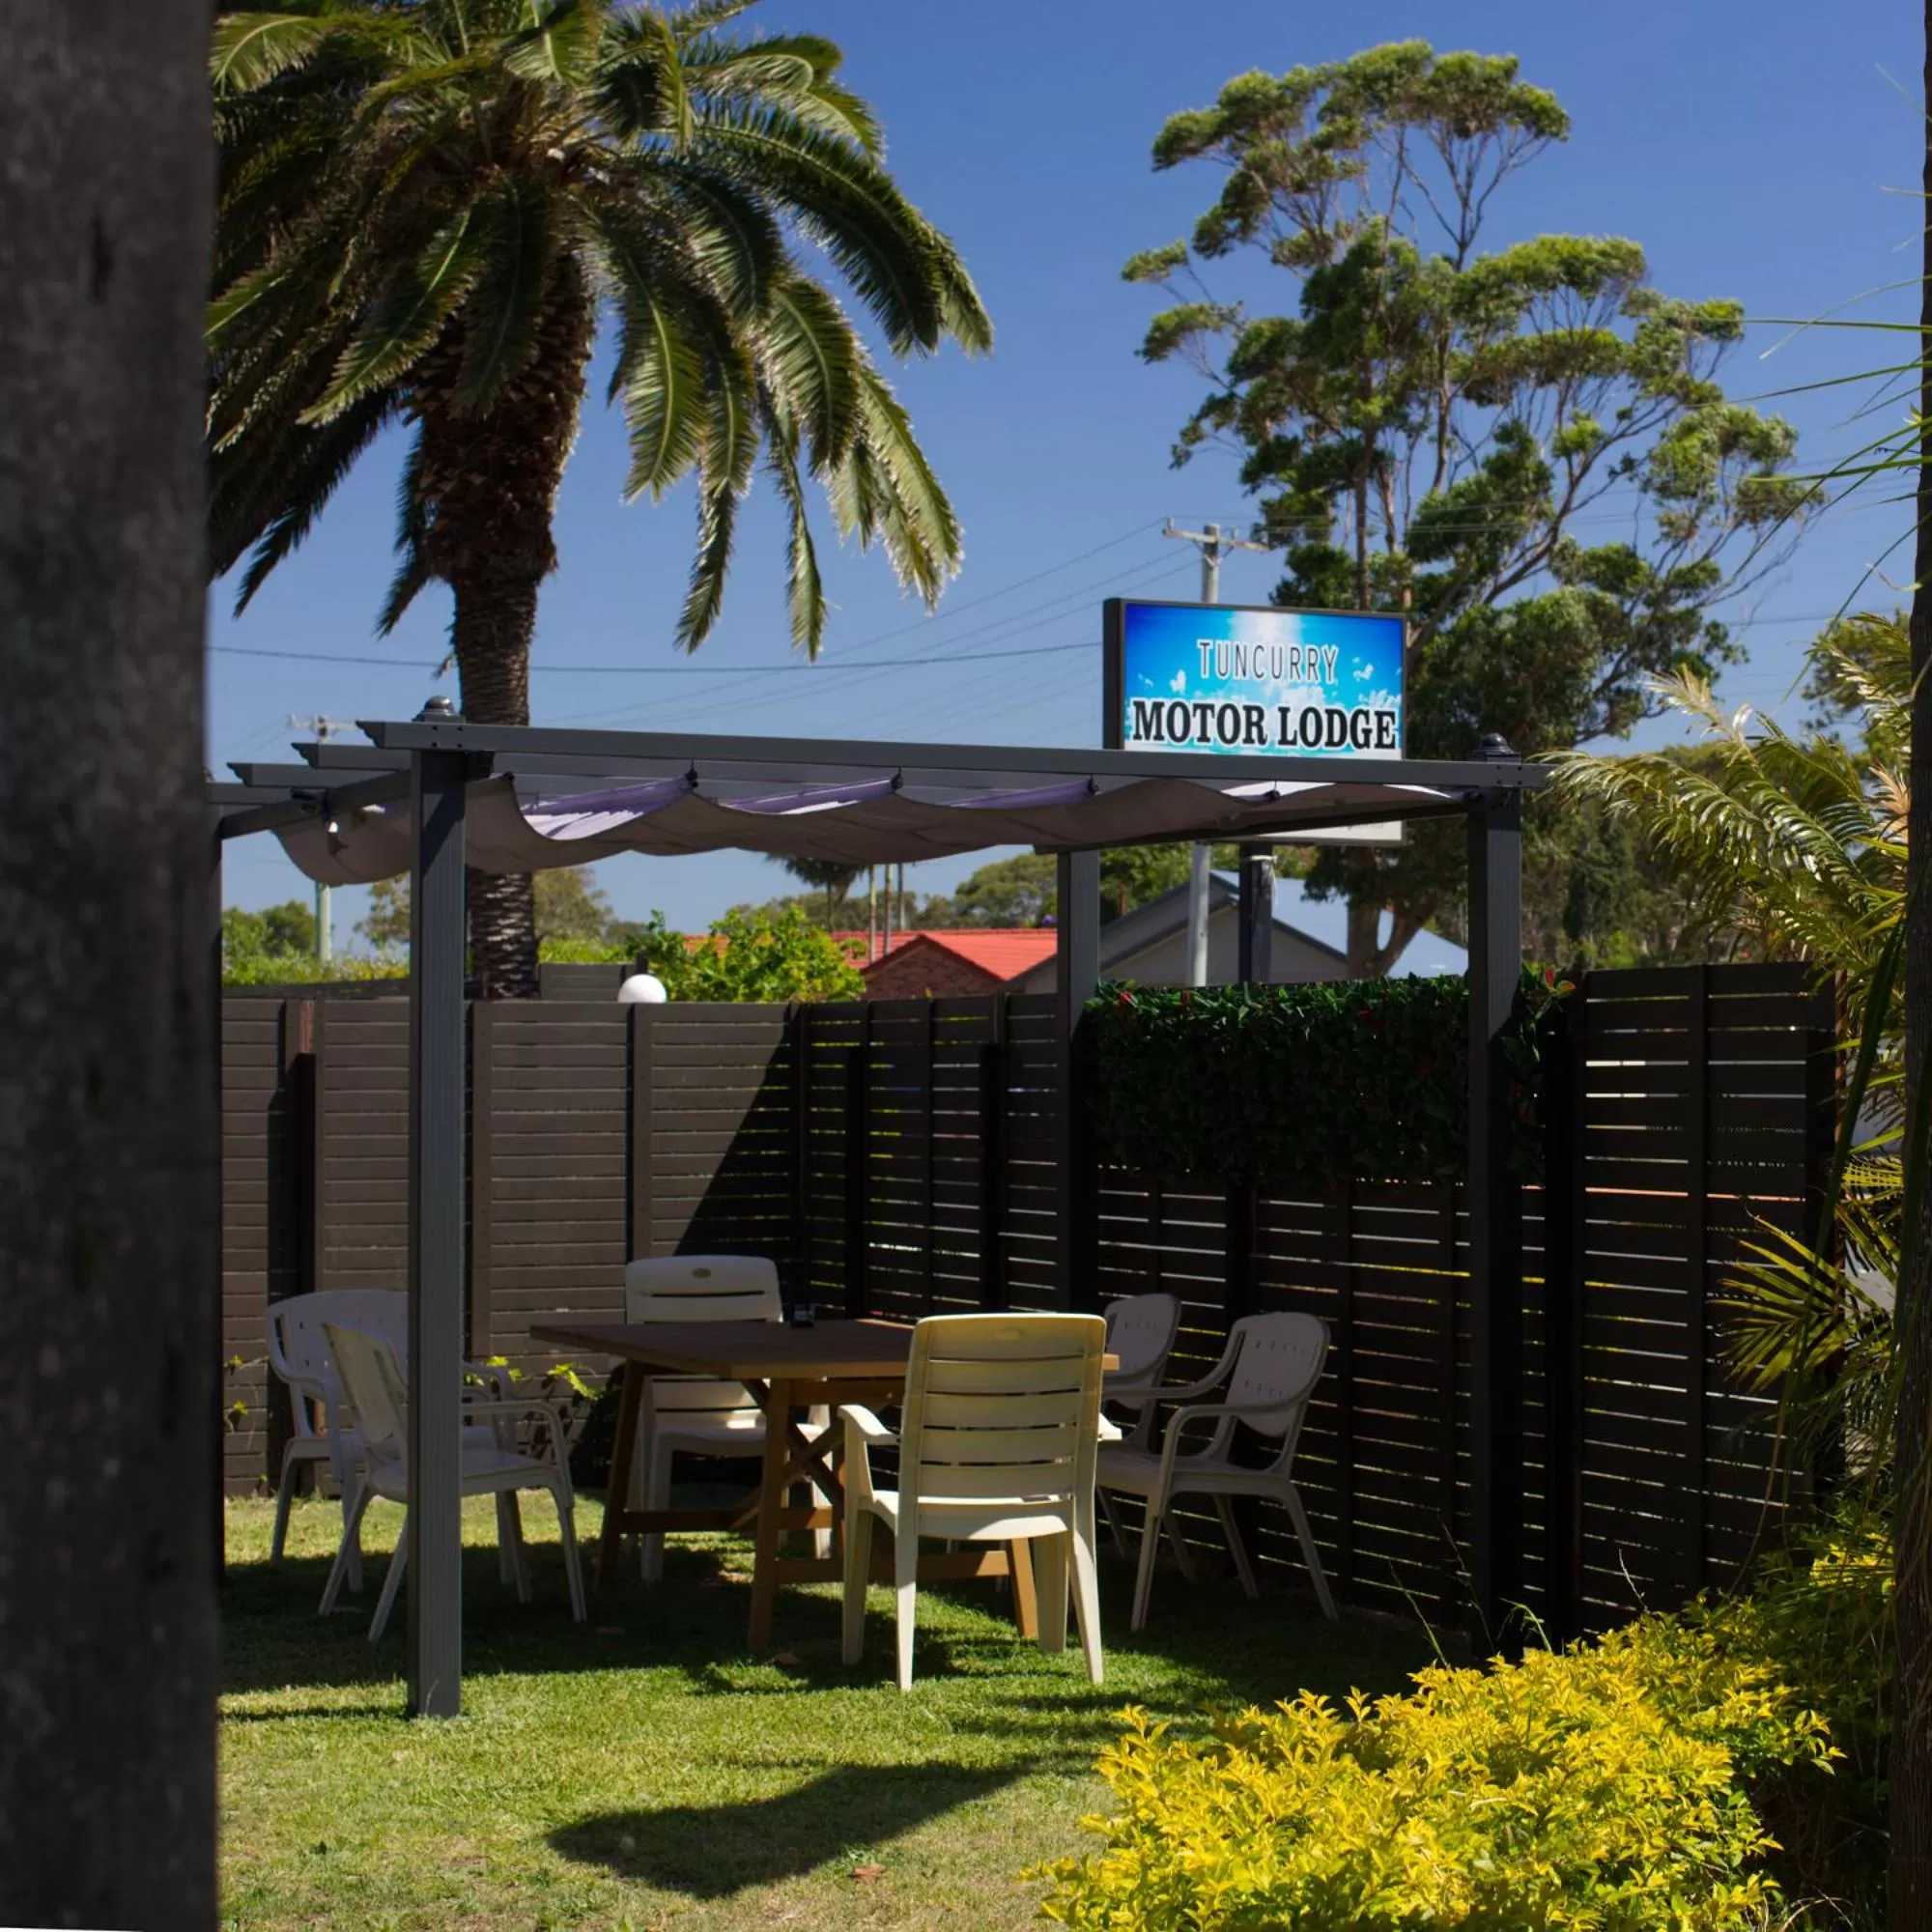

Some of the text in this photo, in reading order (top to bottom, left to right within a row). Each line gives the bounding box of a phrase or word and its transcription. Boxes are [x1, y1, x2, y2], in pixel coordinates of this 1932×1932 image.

[1199, 641, 1338, 682] TUNCURRY
[1132, 700, 1396, 750] MOTOR LODGE
